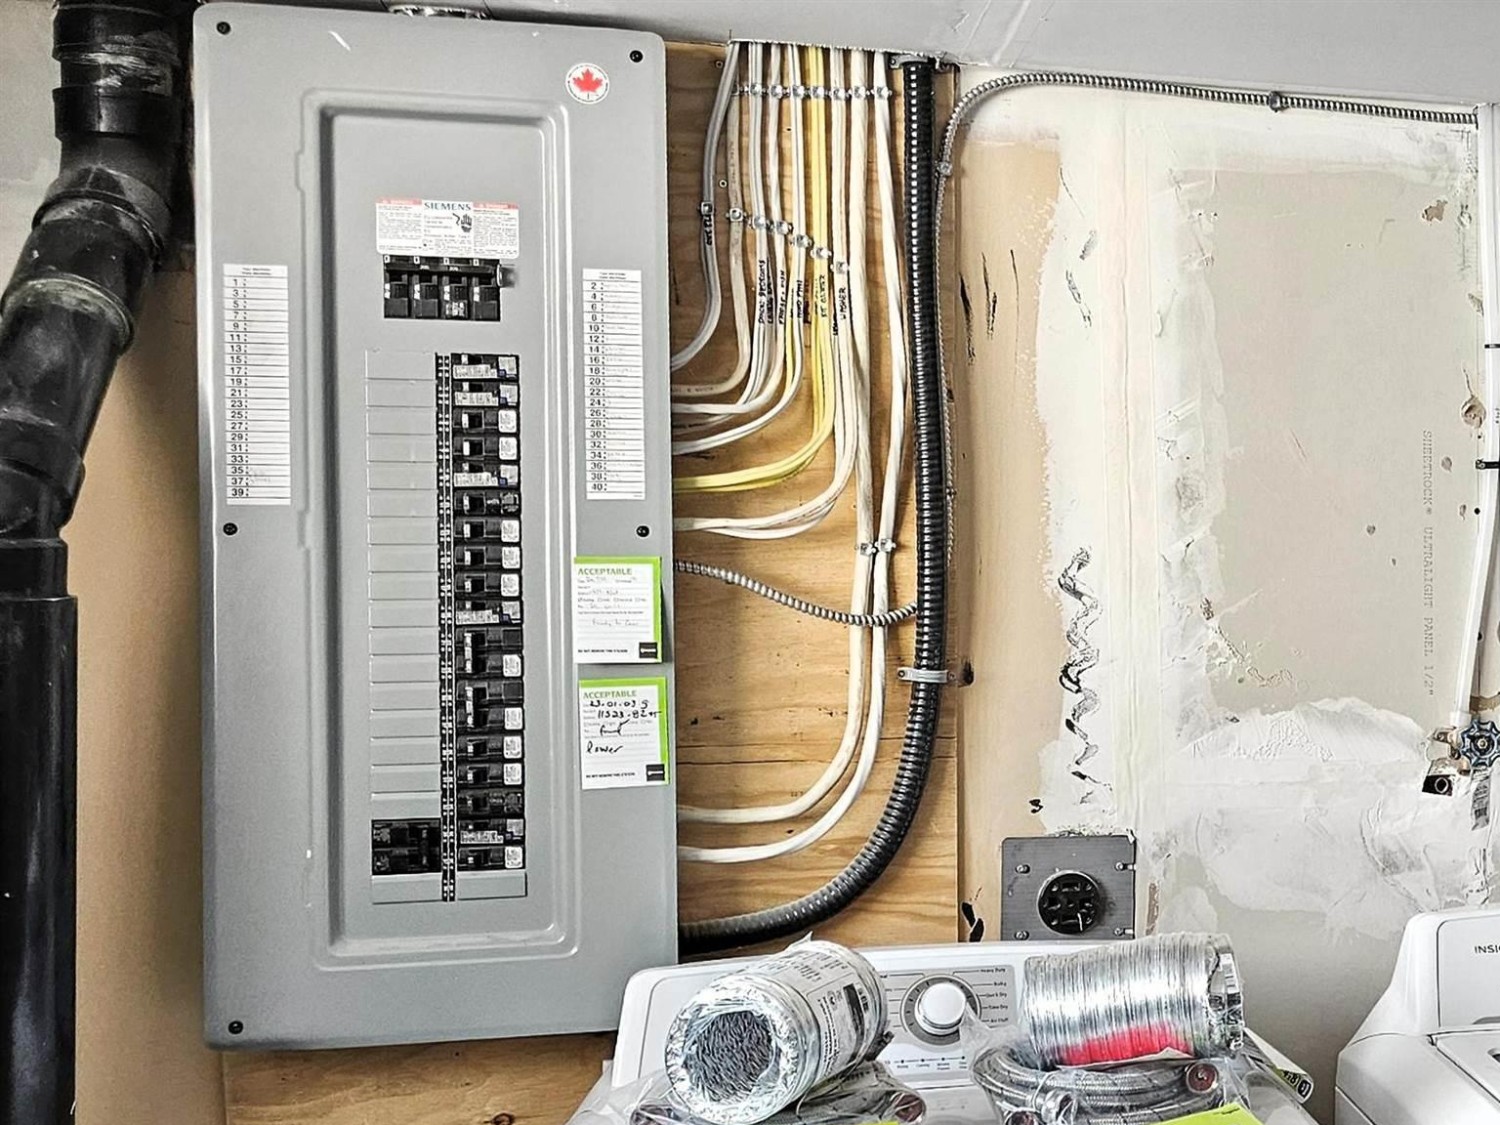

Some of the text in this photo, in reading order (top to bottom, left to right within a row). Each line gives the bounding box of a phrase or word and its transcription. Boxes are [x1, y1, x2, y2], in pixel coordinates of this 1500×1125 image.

[424, 202, 471, 211] SIEMENS
[577, 567, 633, 576] ACCEPTABLE
[1423, 526, 1433, 609] ULTRALIGHT
[1423, 617, 1434, 657] PANEL
[1423, 665, 1434, 696] 1/2"
[583, 689, 637, 699] ACCEPTABLE
